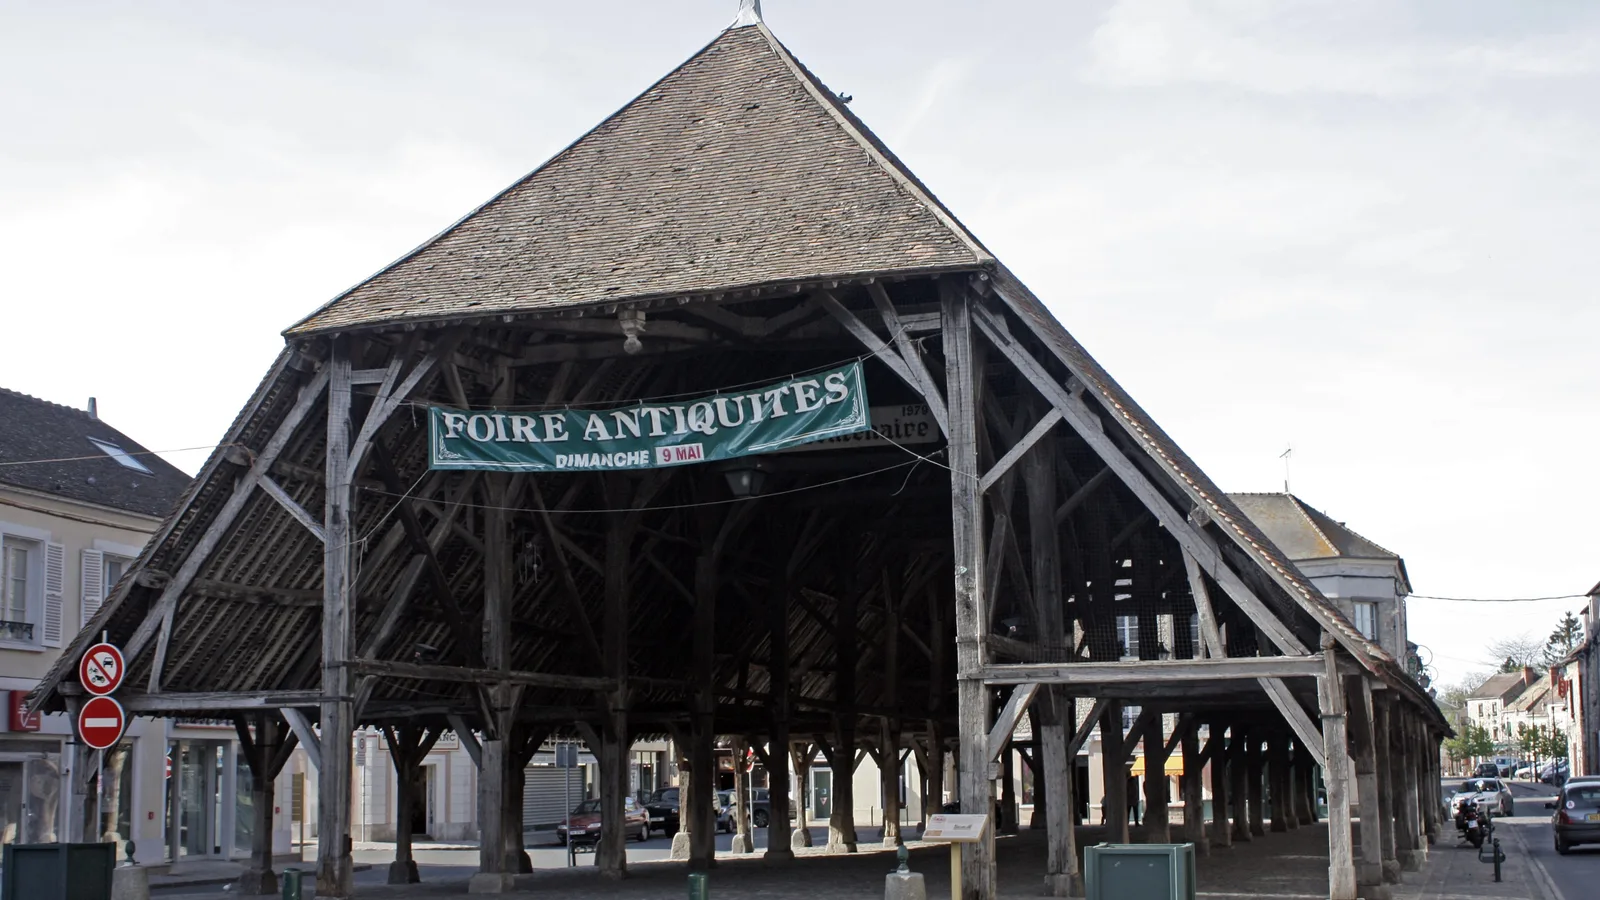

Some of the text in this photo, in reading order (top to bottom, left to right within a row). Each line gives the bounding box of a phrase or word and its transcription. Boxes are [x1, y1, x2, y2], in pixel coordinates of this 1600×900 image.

[442, 371, 849, 443] FOIRE ANTIQUITES
[555, 450, 650, 469] DIMANCHE
[662, 445, 701, 463] 9 MAI
